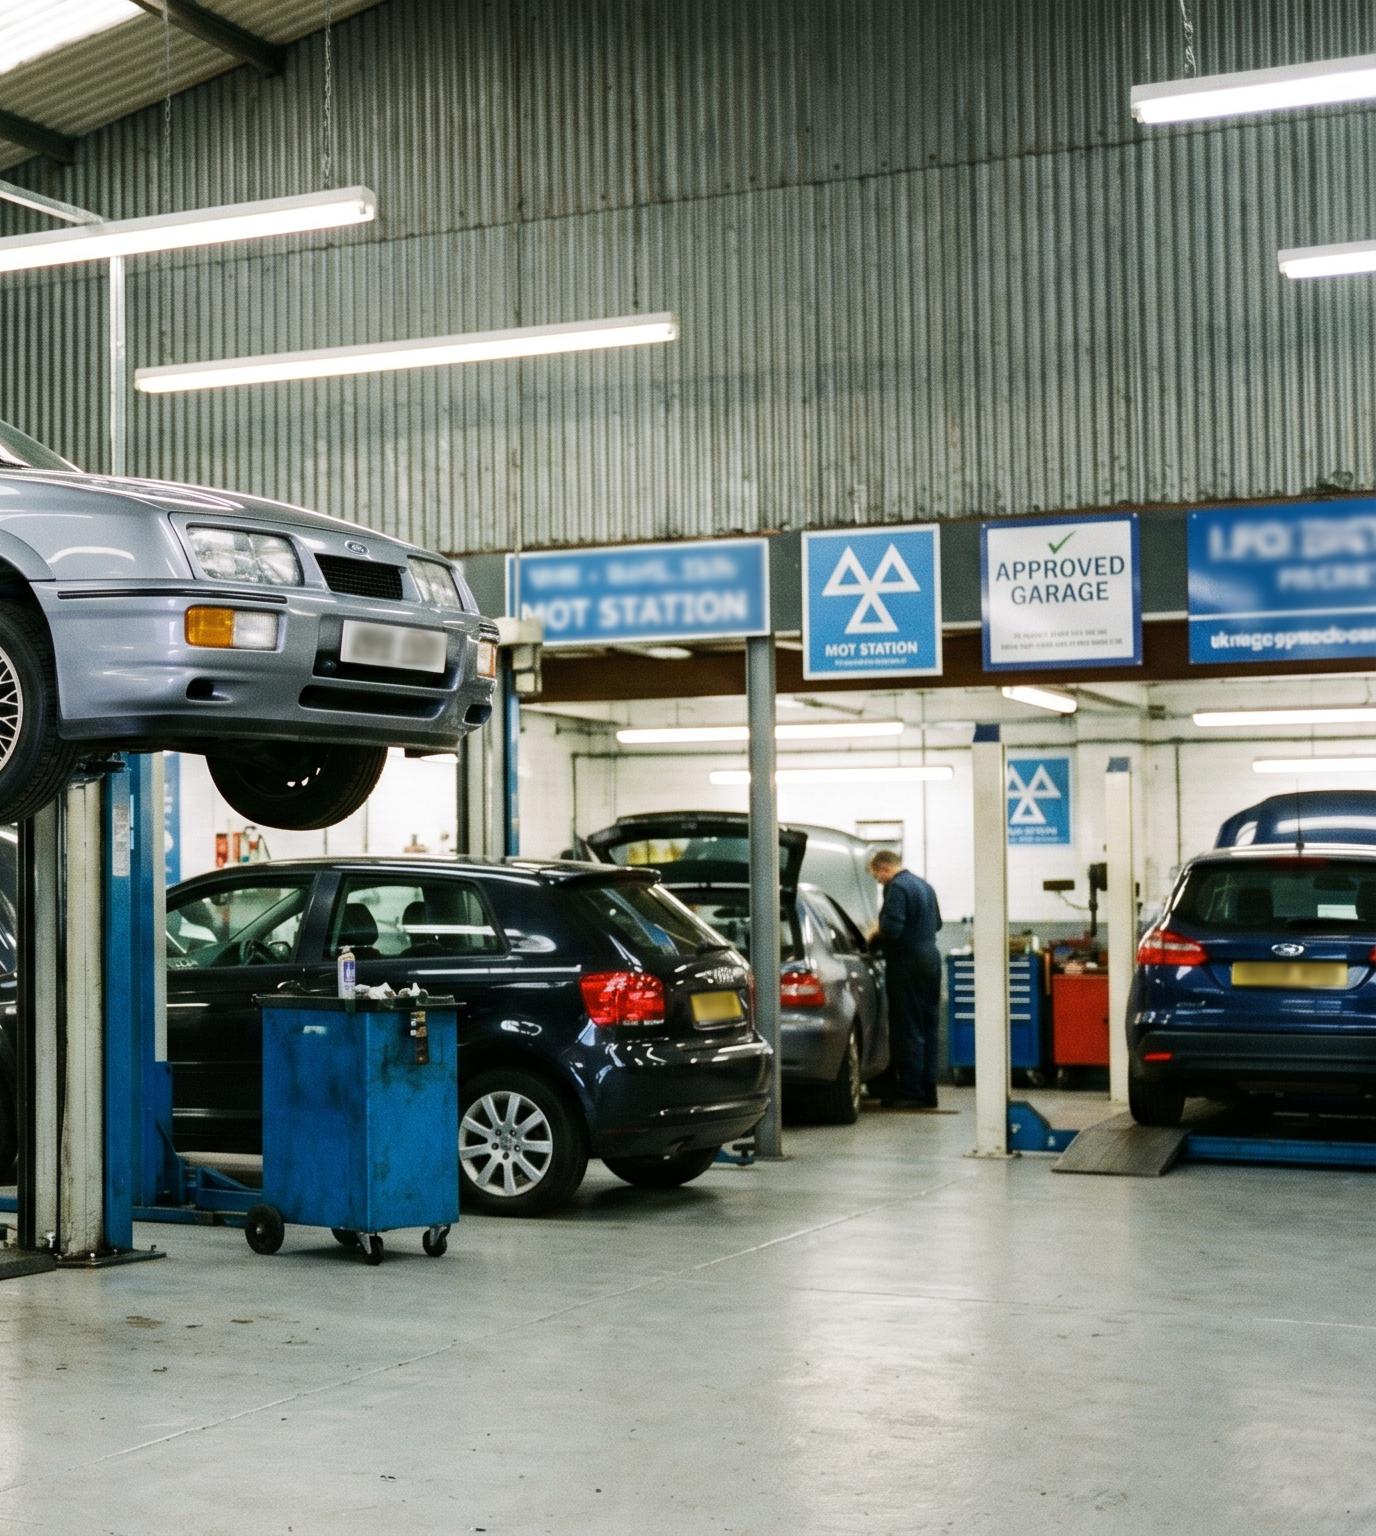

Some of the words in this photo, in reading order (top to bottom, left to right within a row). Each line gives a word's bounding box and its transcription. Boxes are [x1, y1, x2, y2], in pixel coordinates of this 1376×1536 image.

[995, 555, 1125, 582] APPROVED
[1011, 581, 1109, 606] GARAGE
[598, 588, 749, 629] STATION
[825, 642, 857, 657] MOT
[859, 640, 919, 656] STATION
